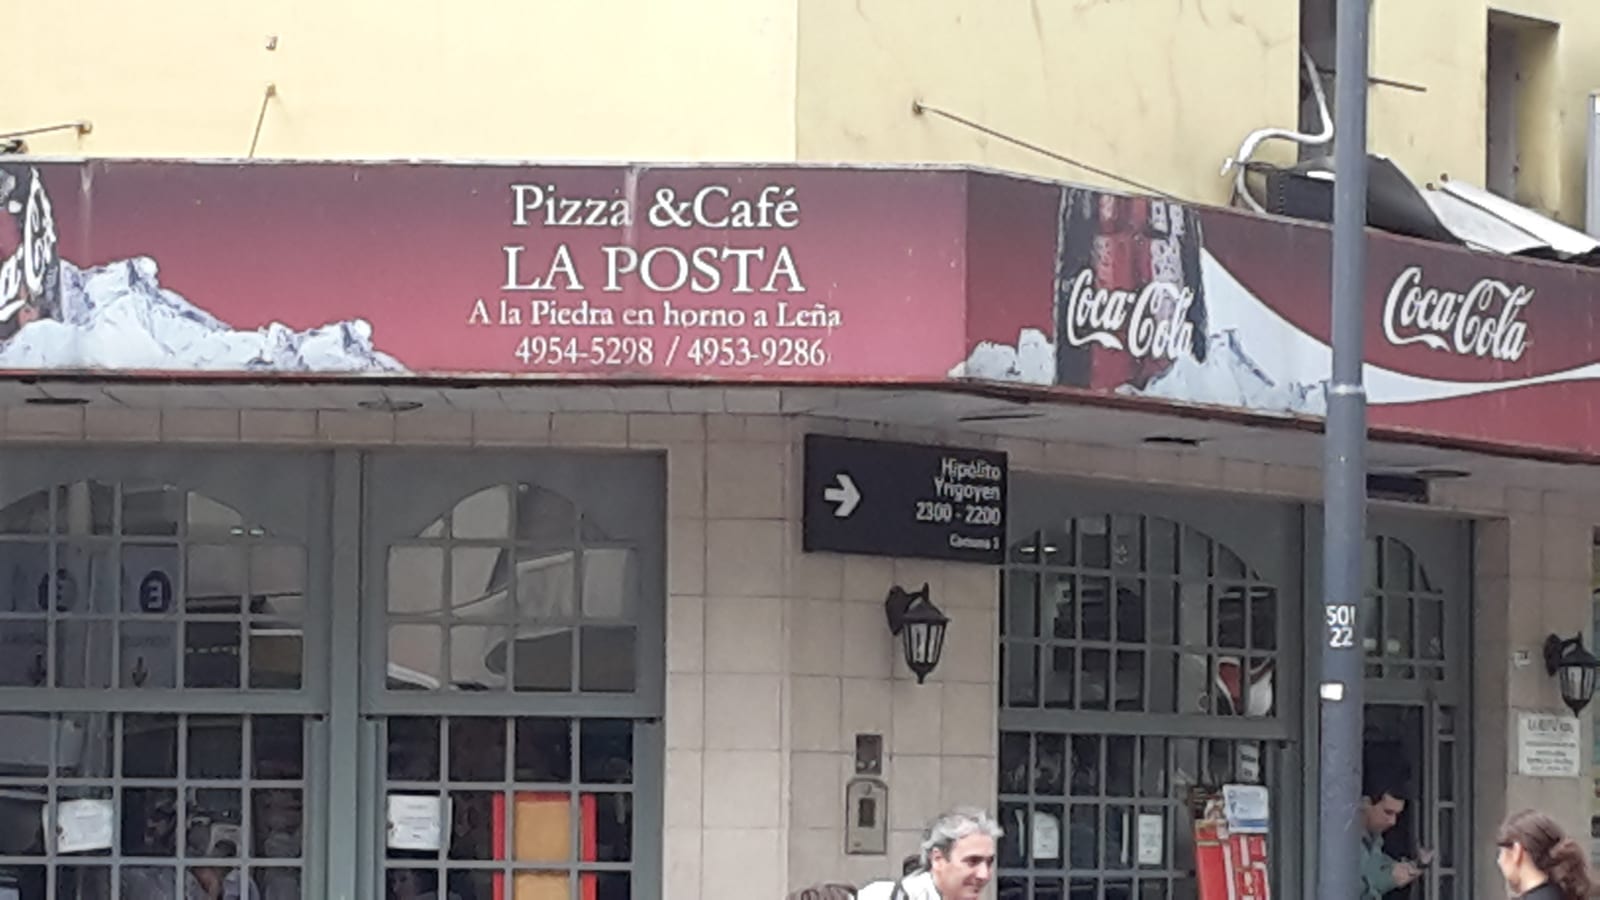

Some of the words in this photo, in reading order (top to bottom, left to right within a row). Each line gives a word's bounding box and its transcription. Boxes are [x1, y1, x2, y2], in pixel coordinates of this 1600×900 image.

[510, 184, 633, 227] Pizza
[648, 186, 799, 228] &Café
[501, 244, 584, 291] LA
[601, 246, 806, 293] POSTA
[468, 299, 492, 325] A
[500, 300, 522, 325] la
[531, 299, 614, 326] Piedra
[622, 308, 655, 326] en
[663, 300, 745, 327] horno
[754, 308, 768, 327] a
[776, 302, 842, 327] Leña
[1067, 268, 1194, 360] Coca-Cola
[1383, 266, 1535, 362] Coca-Cola
[515, 336, 653, 366] 4954-5298
[665, 335, 681, 367] /
[688, 337, 826, 366] 4953-9286
[916, 501, 953, 522] 2300
[965, 504, 1000, 525] 2200
[1330, 626, 1353, 648] 22
